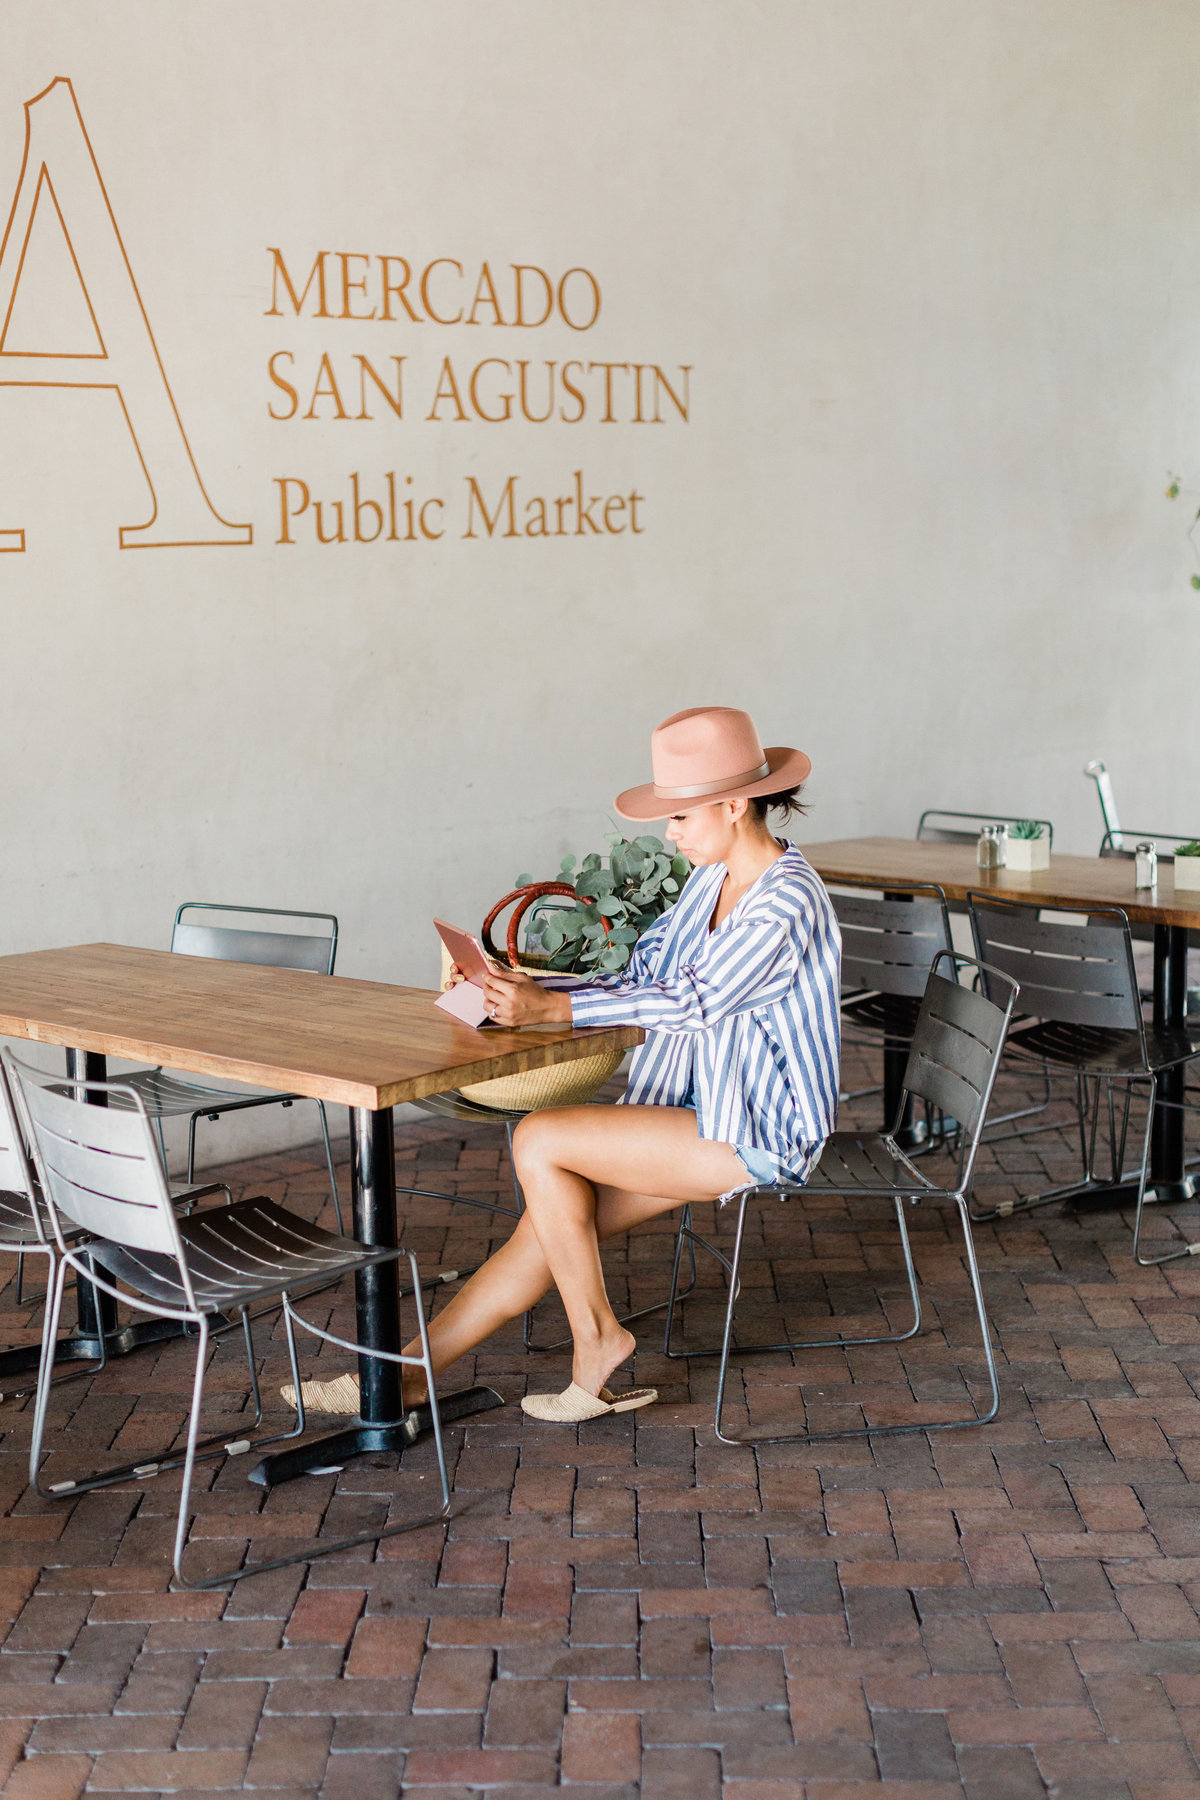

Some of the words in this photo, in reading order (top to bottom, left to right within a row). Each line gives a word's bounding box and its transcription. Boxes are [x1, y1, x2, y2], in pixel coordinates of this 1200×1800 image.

[0, 76, 253, 552] A
[264, 247, 602, 331] MERCADO
[267, 350, 407, 421] SAN
[425, 356, 694, 424] AGUSTIN
[274, 471, 446, 545] Public
[461, 471, 645, 540] Market
